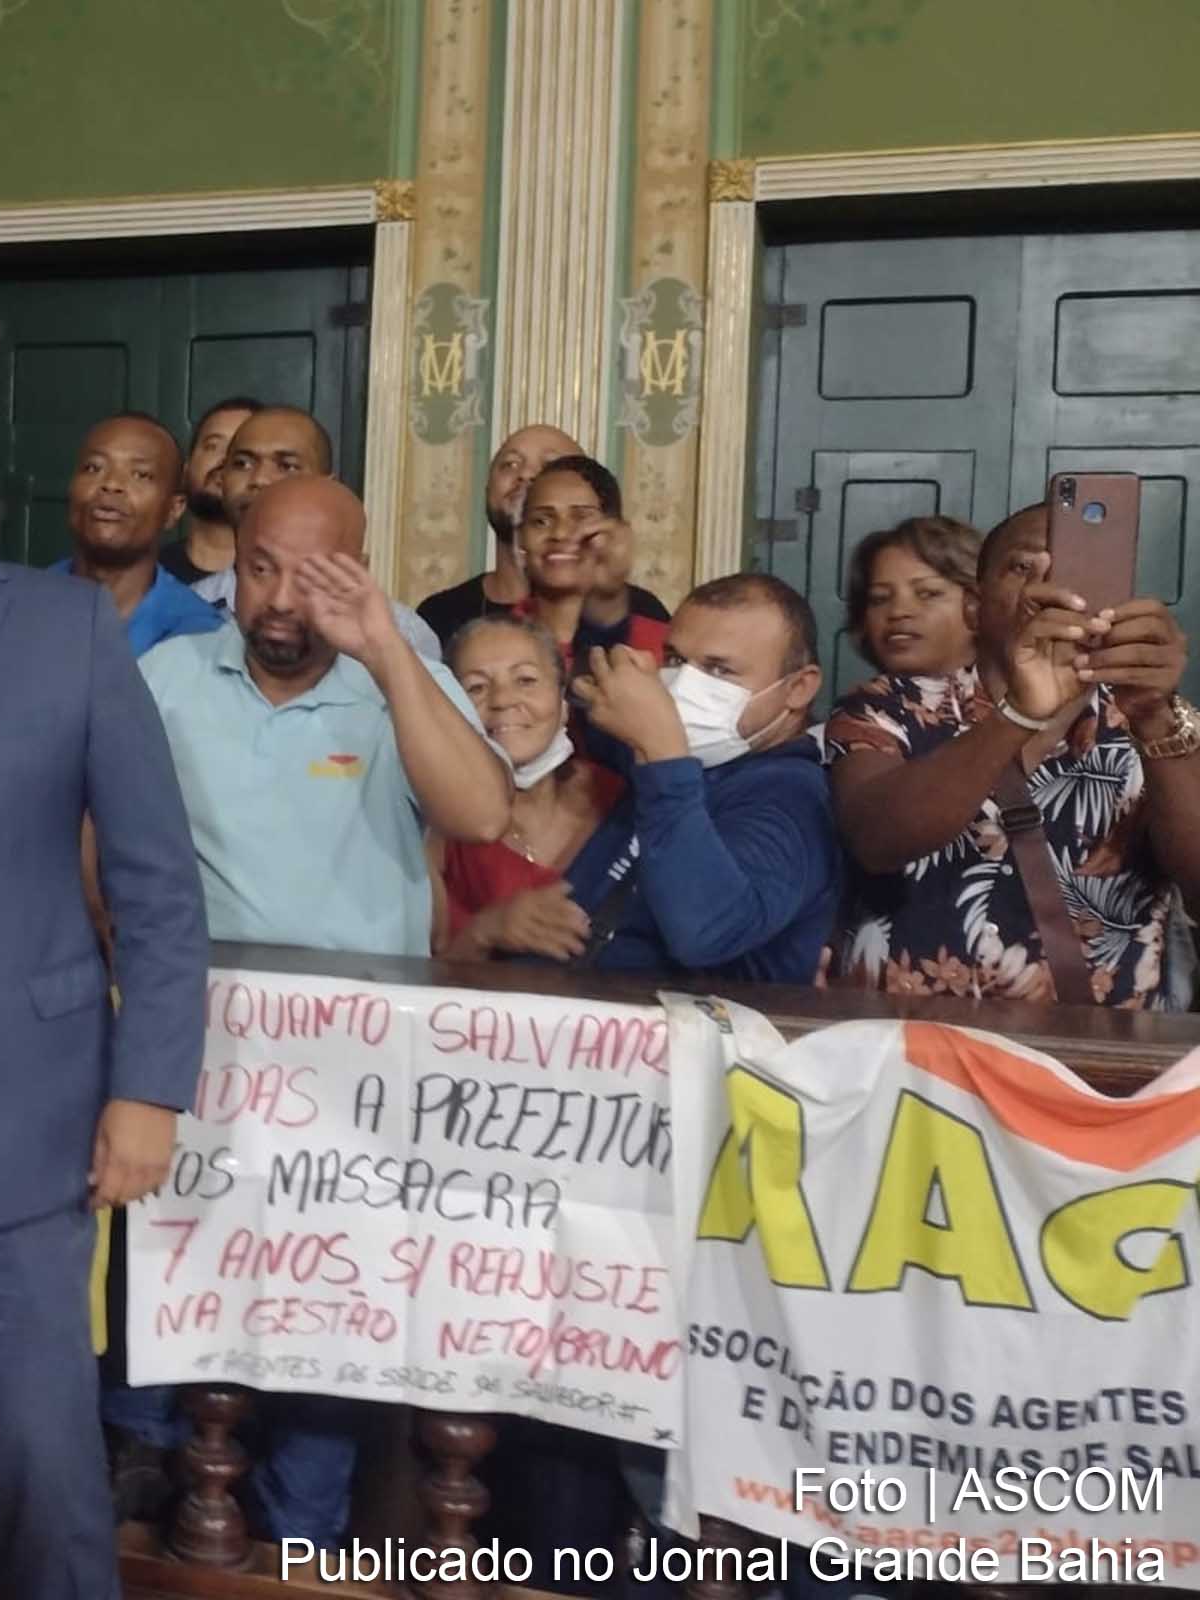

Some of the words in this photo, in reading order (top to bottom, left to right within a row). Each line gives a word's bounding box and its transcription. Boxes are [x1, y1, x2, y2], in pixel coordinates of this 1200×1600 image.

[354, 1073, 386, 1134] A
[159, 1146, 235, 1200] OS
[266, 1149, 562, 1229] MASSACRA
[150, 1217, 200, 1284] 7
[218, 1228, 360, 1286] ANOS
[448, 1240, 670, 1315] REAJUSTE
[155, 1290, 223, 1339] NA
[741, 1384, 766, 1422] E
[828, 1430, 1044, 1482] ENDEMIAS
[890, 1376, 976, 1426] DOS
[990, 1386, 1188, 1432] AGENTES
